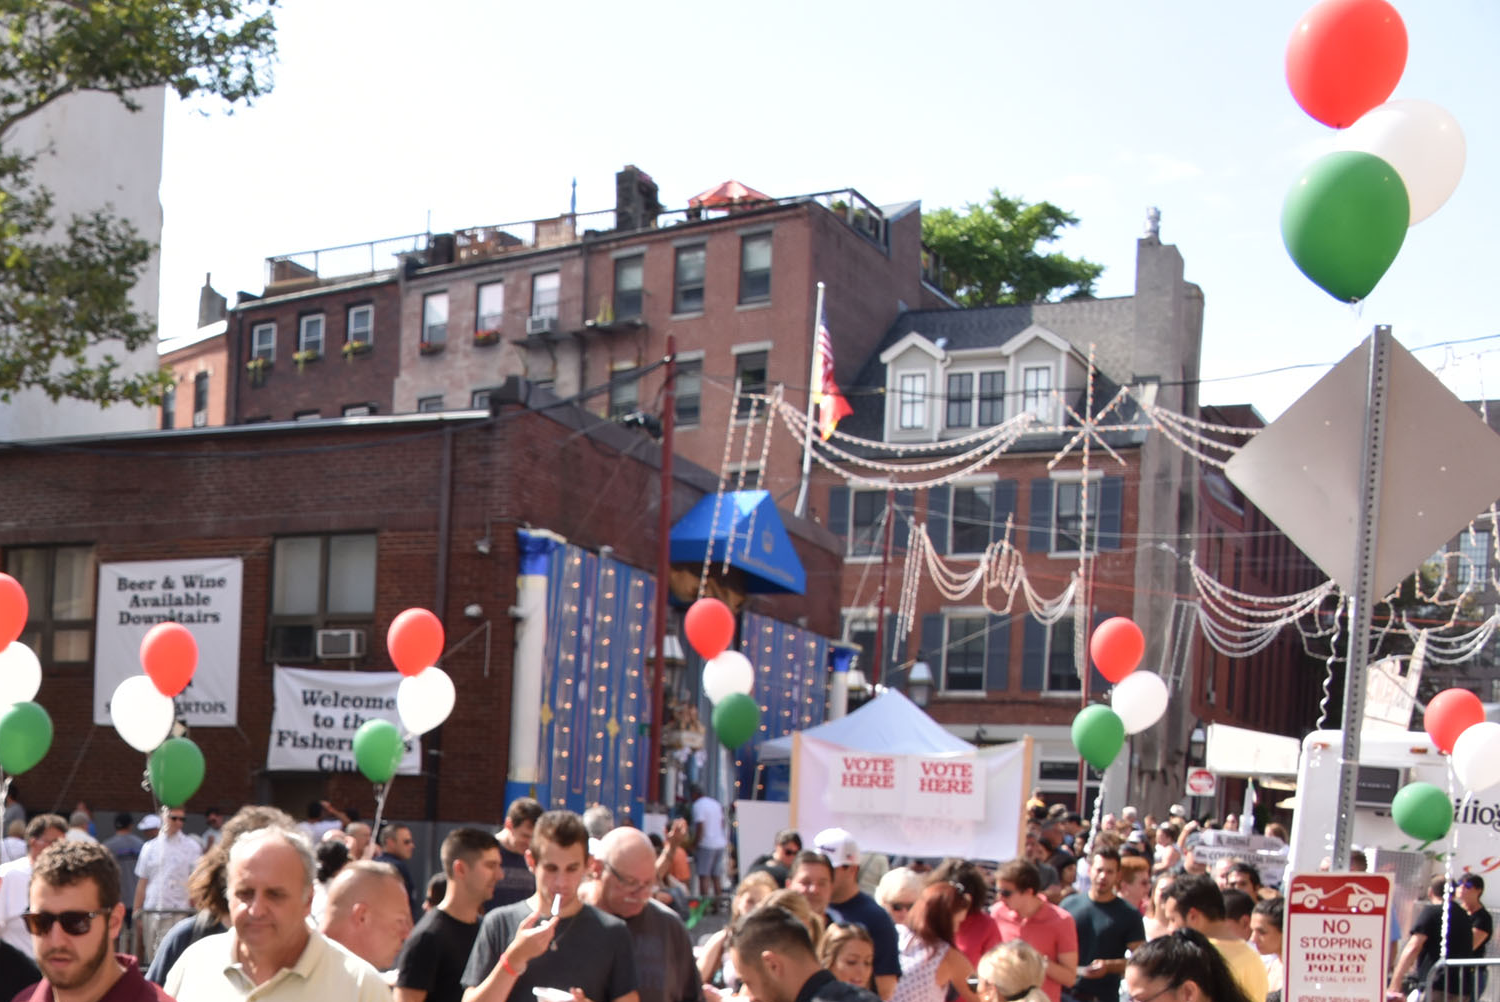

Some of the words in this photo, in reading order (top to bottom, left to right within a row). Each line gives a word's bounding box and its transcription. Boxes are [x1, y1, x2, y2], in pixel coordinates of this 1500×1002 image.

[117, 577, 156, 591] Beer
[162, 575, 175, 590] &
[183, 574, 226, 588] Wine
[129, 593, 212, 608] Available
[118, 611, 220, 626] Downstairs
[301, 689, 396, 711] Welcome
[313, 712, 334, 728] to
[342, 713, 376, 731] th
[317, 753, 360, 773] Clu
[843, 757, 894, 771] VOTE
[920, 762, 972, 777] VOTE
[841, 773, 894, 788] HERE
[919, 778, 972, 794] HERE
[1323, 919, 1350, 934] NO
[1300, 936, 1372, 949] STOPPING
[1305, 952, 1367, 963] BOSTON
[1308, 963, 1364, 974] POLICE
